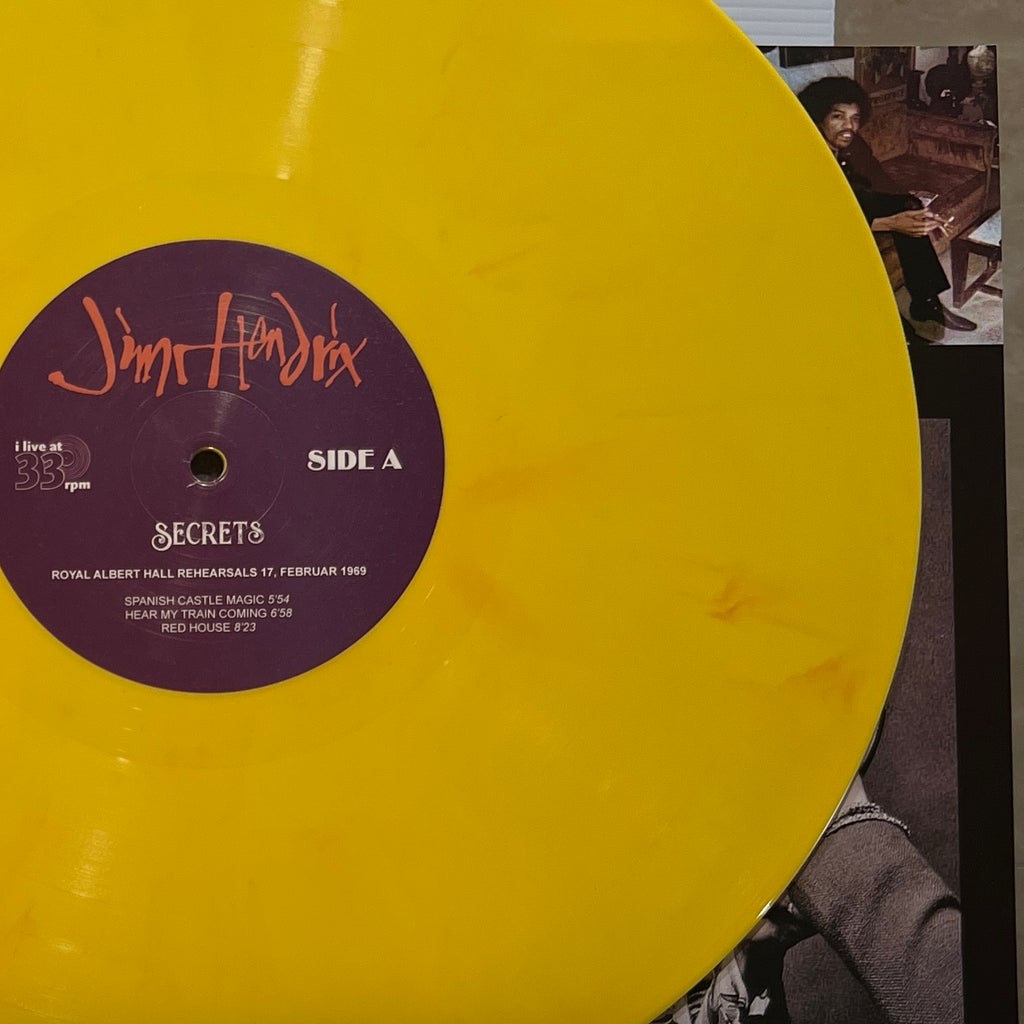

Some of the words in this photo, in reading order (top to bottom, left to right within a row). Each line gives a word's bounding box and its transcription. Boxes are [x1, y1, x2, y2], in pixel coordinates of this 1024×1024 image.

[207, 291, 367, 391] Hendrix
[15, 441, 19, 452] i
[22, 440, 47, 452] live
[49, 442, 63, 452] at
[307, 449, 374, 471] SIDE
[381, 449, 402, 470] A
[15, 452, 65, 490] 33
[64, 481, 91, 493] rpm
[151, 521, 265, 551] SECRETS
[51, 570, 91, 580] ROYAL
[93, 569, 140, 580] ALBERT
[143, 569, 174, 579] HALL
[177, 568, 257, 578] REHEARSALS
[261, 567, 276, 578] 17,
[280, 566, 337, 577] FEBRUAR
[341, 566, 367, 576] 1969
[124, 596, 175, 606] SPANISH
[177, 595, 223, 606] CASTLE
[226, 594, 265, 605] MAGIC
[268, 594, 290, 605] 5'54
[125, 610, 158, 619] HEAR
[160, 610, 178, 619] MY
[181, 609, 216, 619] TRAIN
[218, 608, 267, 619] COMING
[270, 608, 293, 618] 6'58
[161, 623, 186, 633] RED
[189, 622, 230, 633] HOUSE
[234, 622, 256, 632] 8'23
